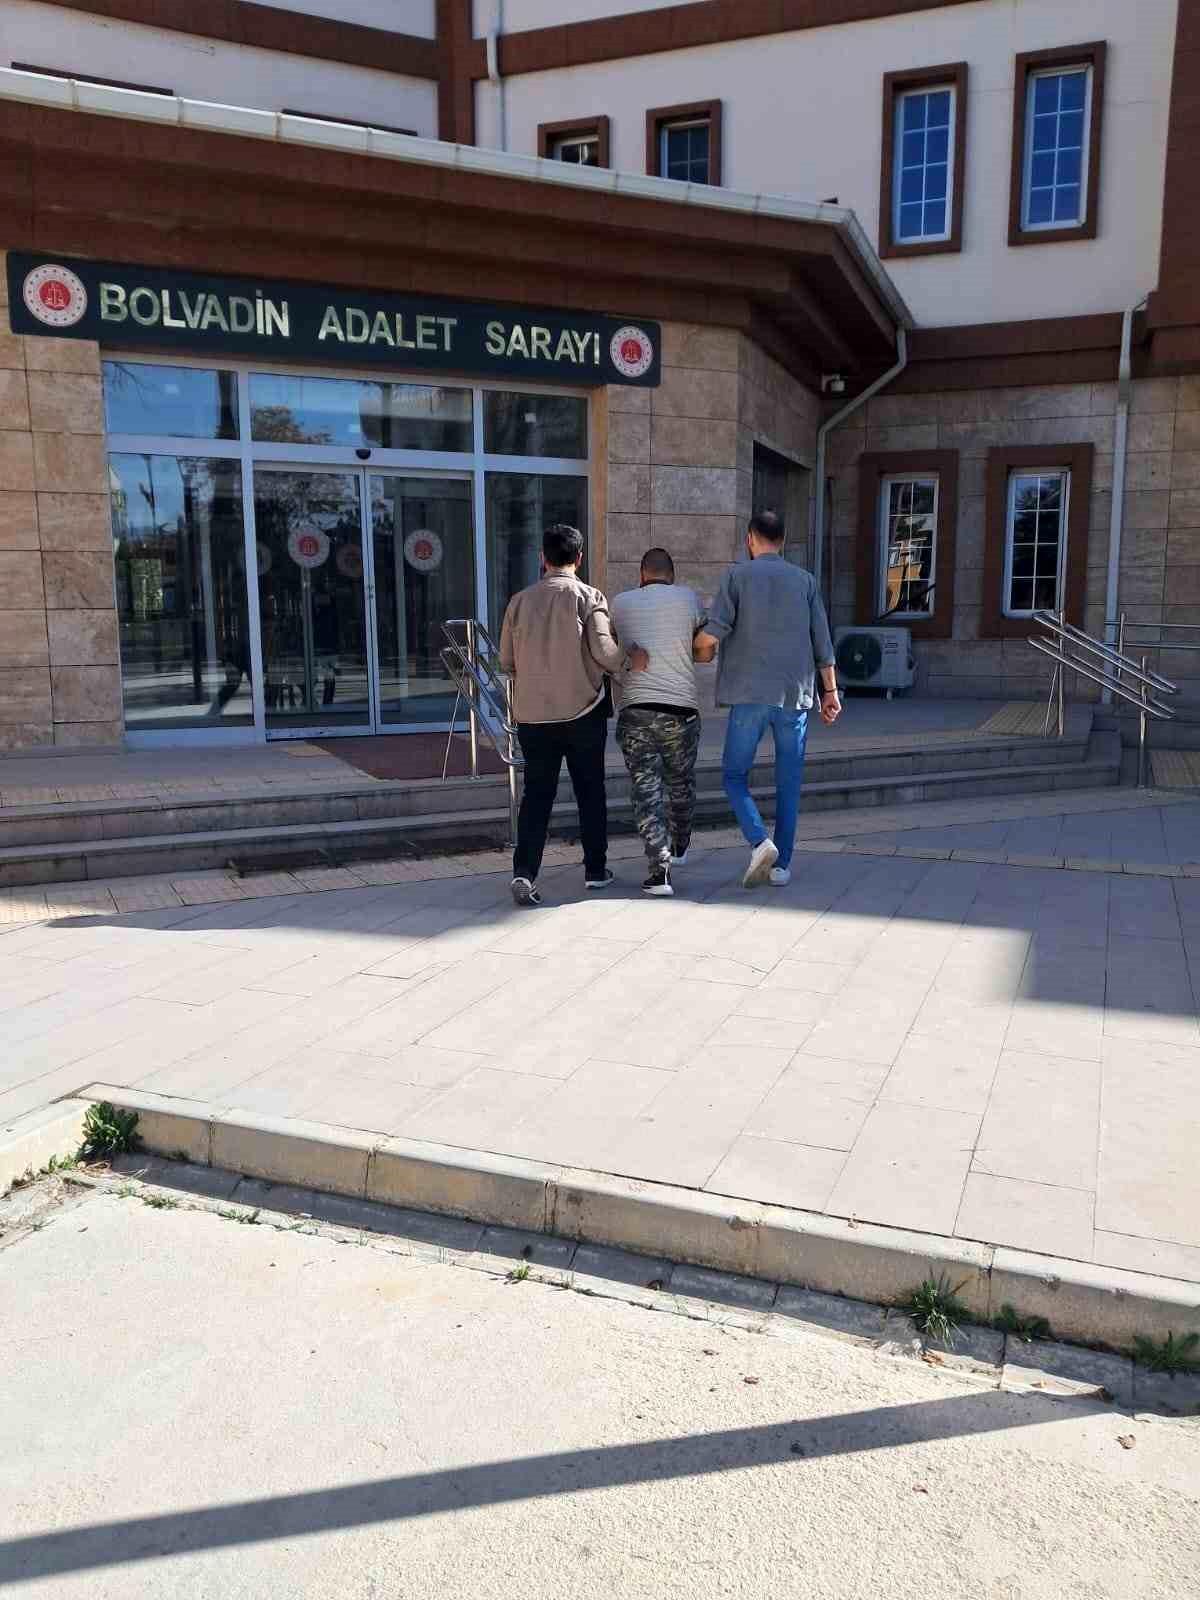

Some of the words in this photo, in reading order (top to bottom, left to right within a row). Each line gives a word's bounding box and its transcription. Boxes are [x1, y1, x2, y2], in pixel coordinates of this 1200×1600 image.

[100, 283, 289, 337] BOLVADİN
[318, 306, 457, 351] ADALET
[486, 322, 600, 364] SARAYI
